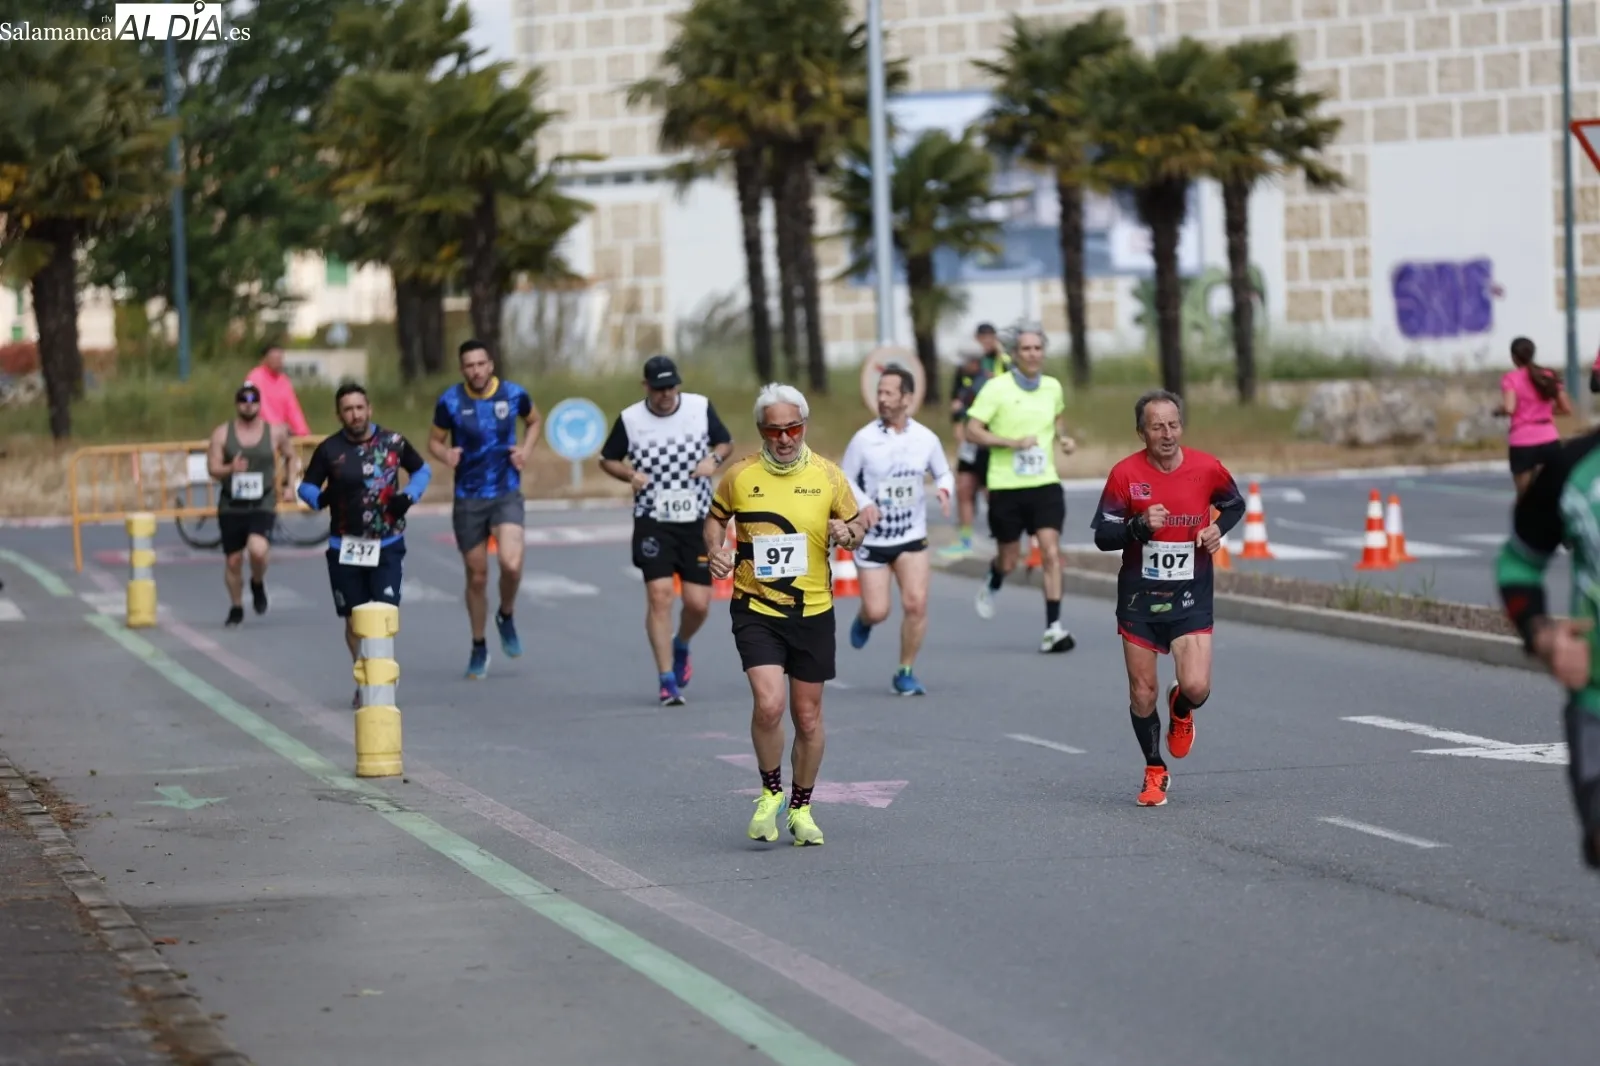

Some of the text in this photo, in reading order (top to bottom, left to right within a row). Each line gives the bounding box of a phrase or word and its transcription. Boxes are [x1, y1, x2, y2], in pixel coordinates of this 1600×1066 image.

[885, 486, 913, 498] 161
[662, 500, 691, 512] 160
[346, 543, 375, 557] 237
[766, 546, 795, 565] 97
[1149, 552, 1189, 569] 107
